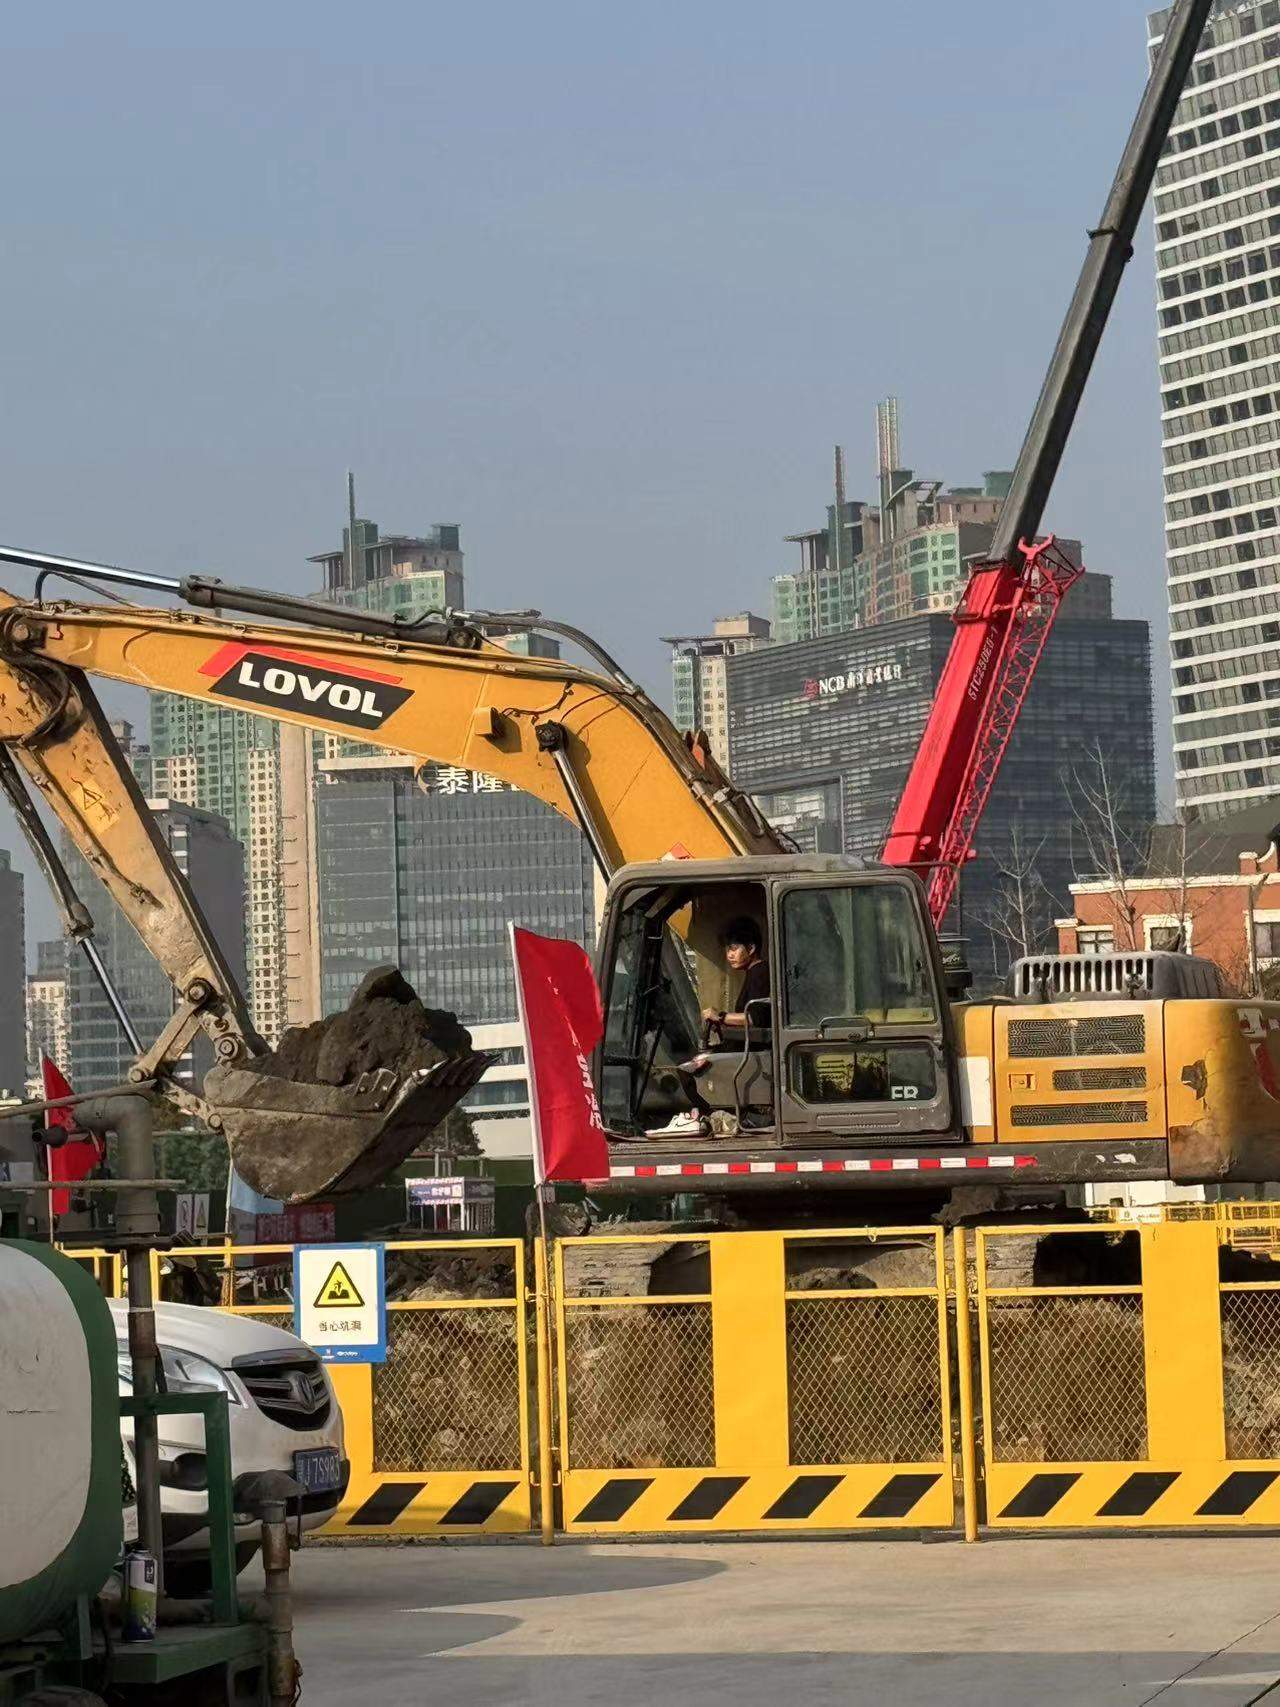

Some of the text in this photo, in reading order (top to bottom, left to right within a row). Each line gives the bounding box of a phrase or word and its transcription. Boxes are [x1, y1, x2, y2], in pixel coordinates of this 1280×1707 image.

[238, 661, 383, 718] LOVOL
[819, 675, 845, 695] NCB
[436, 766, 521, 795] 泰隆
